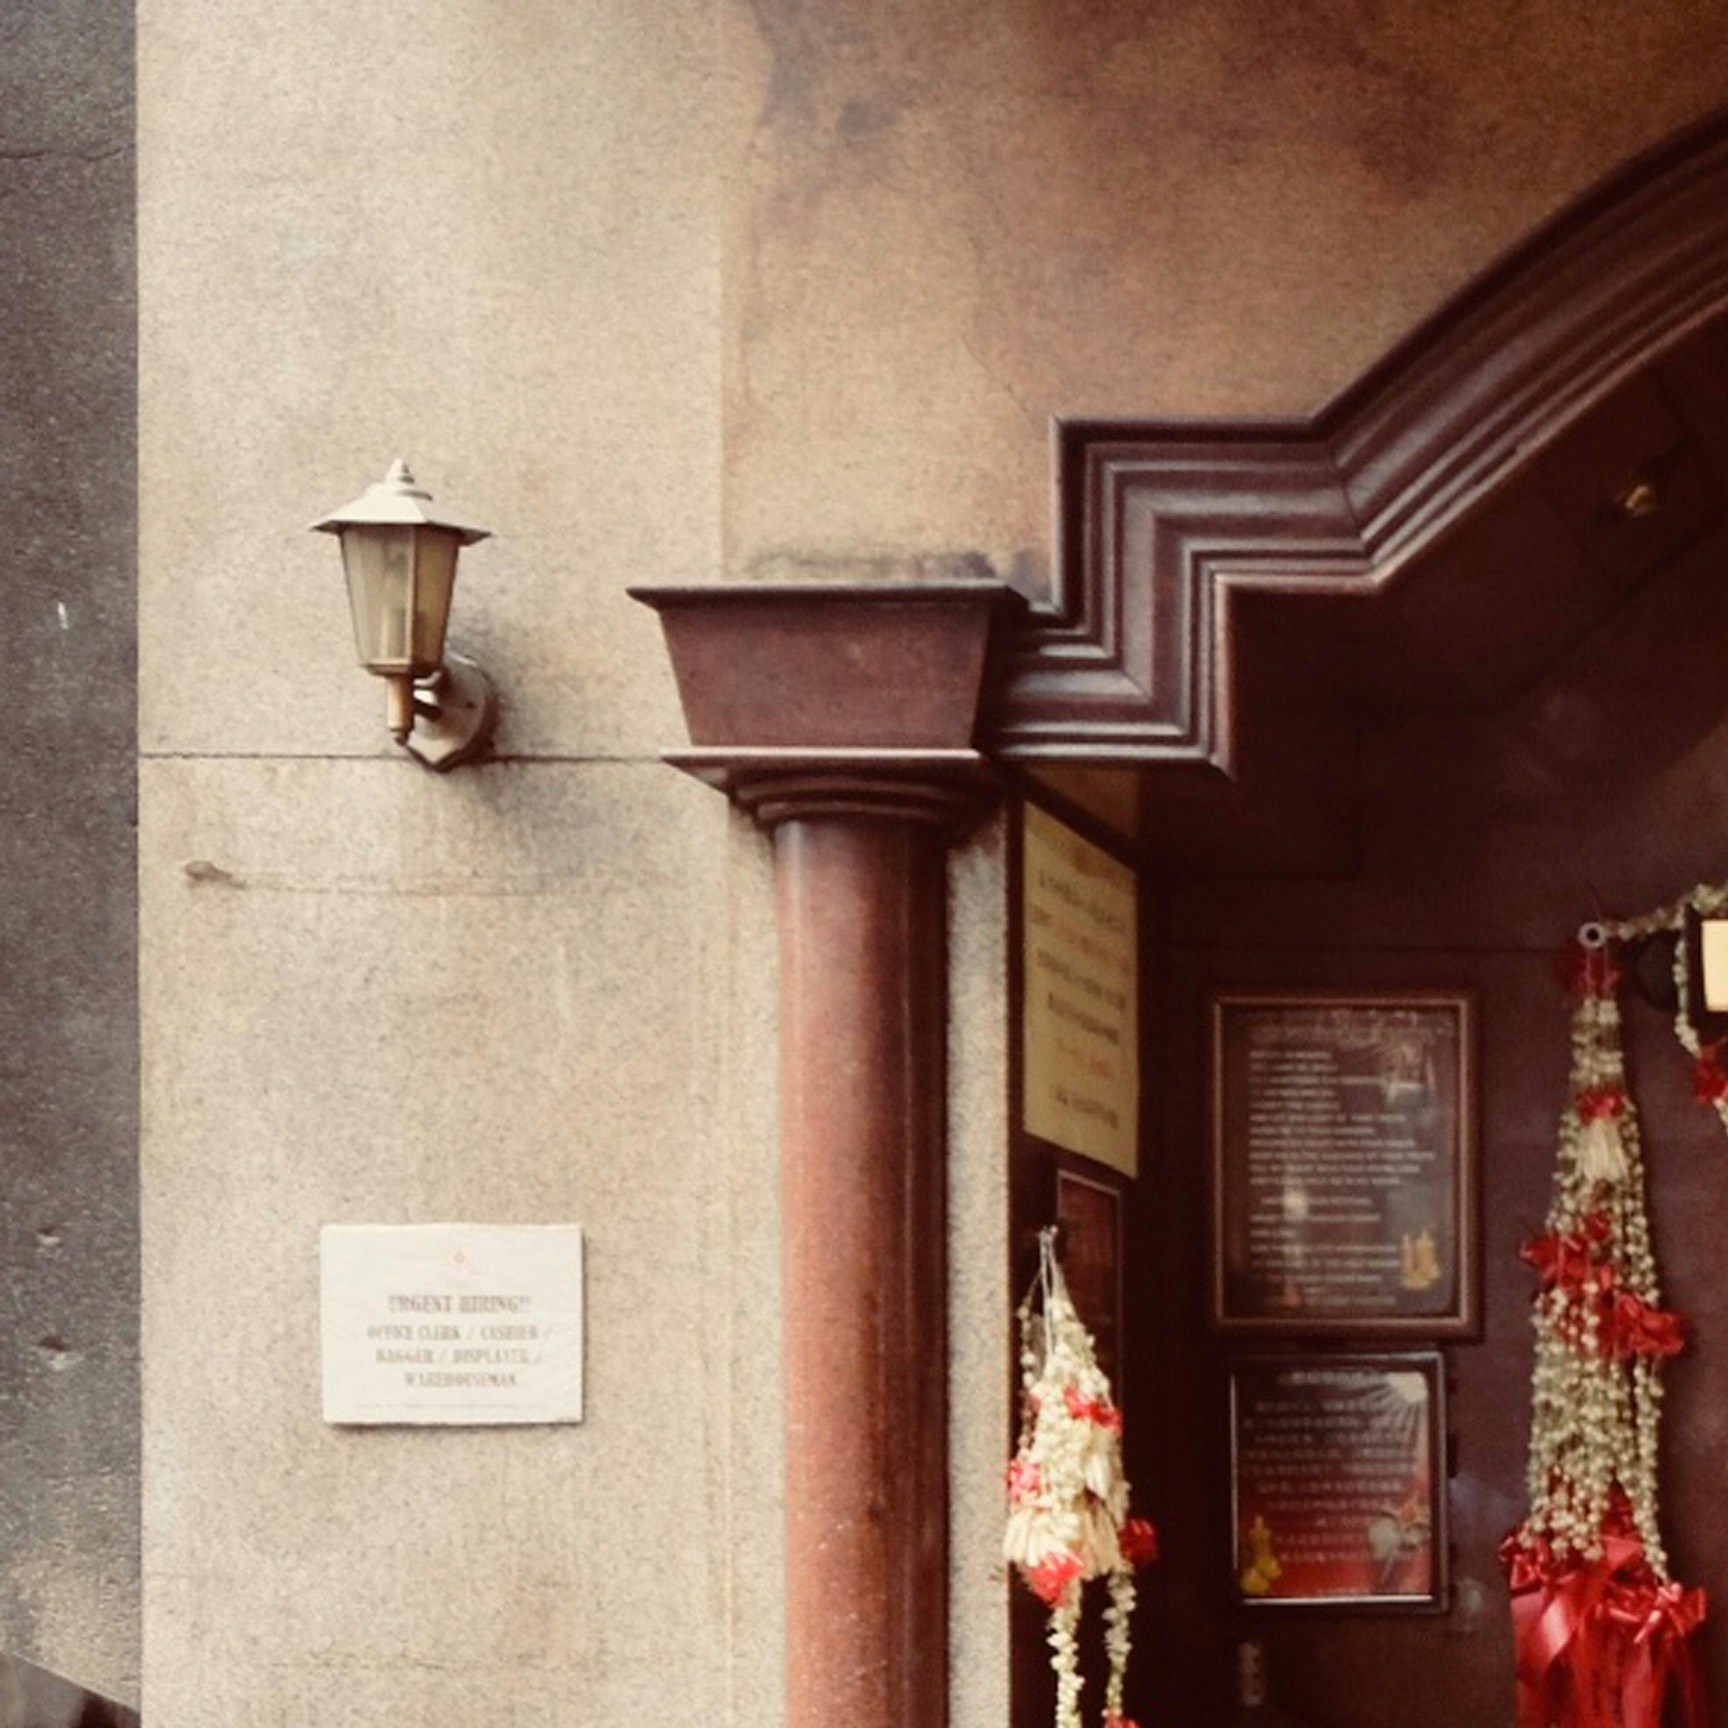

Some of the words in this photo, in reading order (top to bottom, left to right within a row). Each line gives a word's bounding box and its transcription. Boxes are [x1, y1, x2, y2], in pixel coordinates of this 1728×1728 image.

[388, 1295, 451, 1313] URGENT
[367, 1325, 412, 1340] OFFICE
[418, 1325, 460, 1340] CLERK
[481, 1325, 537, 1340] CASHIER
[376, 1349, 433, 1363] BAGGER
[404, 1372, 516, 1387] WAREHOUSEMAN
